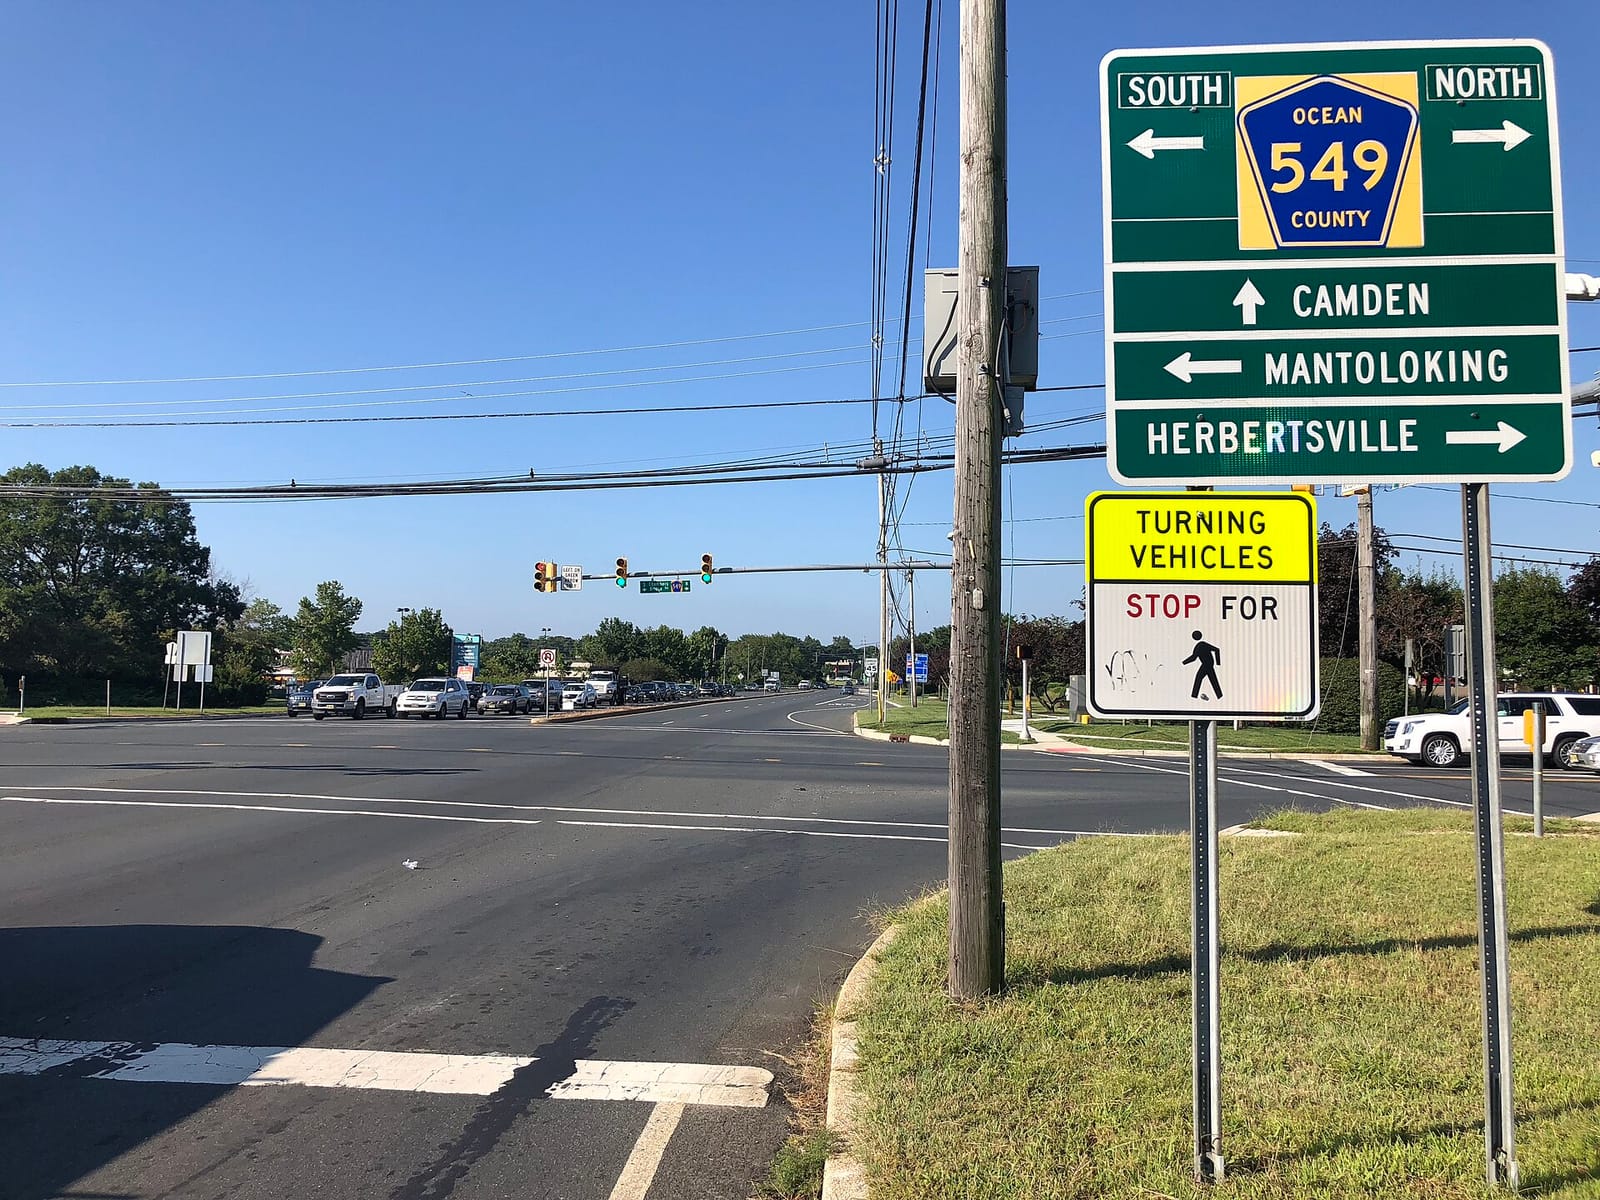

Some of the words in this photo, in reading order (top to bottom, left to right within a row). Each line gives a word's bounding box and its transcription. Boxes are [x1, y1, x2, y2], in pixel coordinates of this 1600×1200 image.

[1127, 75, 1223, 106] SOUTH
[1435, 67, 1532, 98] NORTH
[1293, 107, 1362, 124] OCEAN
[1270, 141, 1389, 193] 549
[1291, 210, 1371, 228] COUNTY
[1293, 283, 1430, 317] CAMDEN
[1265, 350, 1509, 385] MANTOLOKING
[1147, 419, 1419, 455] HERBERTSVILLE
[1136, 510, 1266, 535] TURNING
[1130, 545, 1273, 570] VEHICLES
[1126, 593, 1201, 619] STOP
[1222, 595, 1279, 621] FOR
